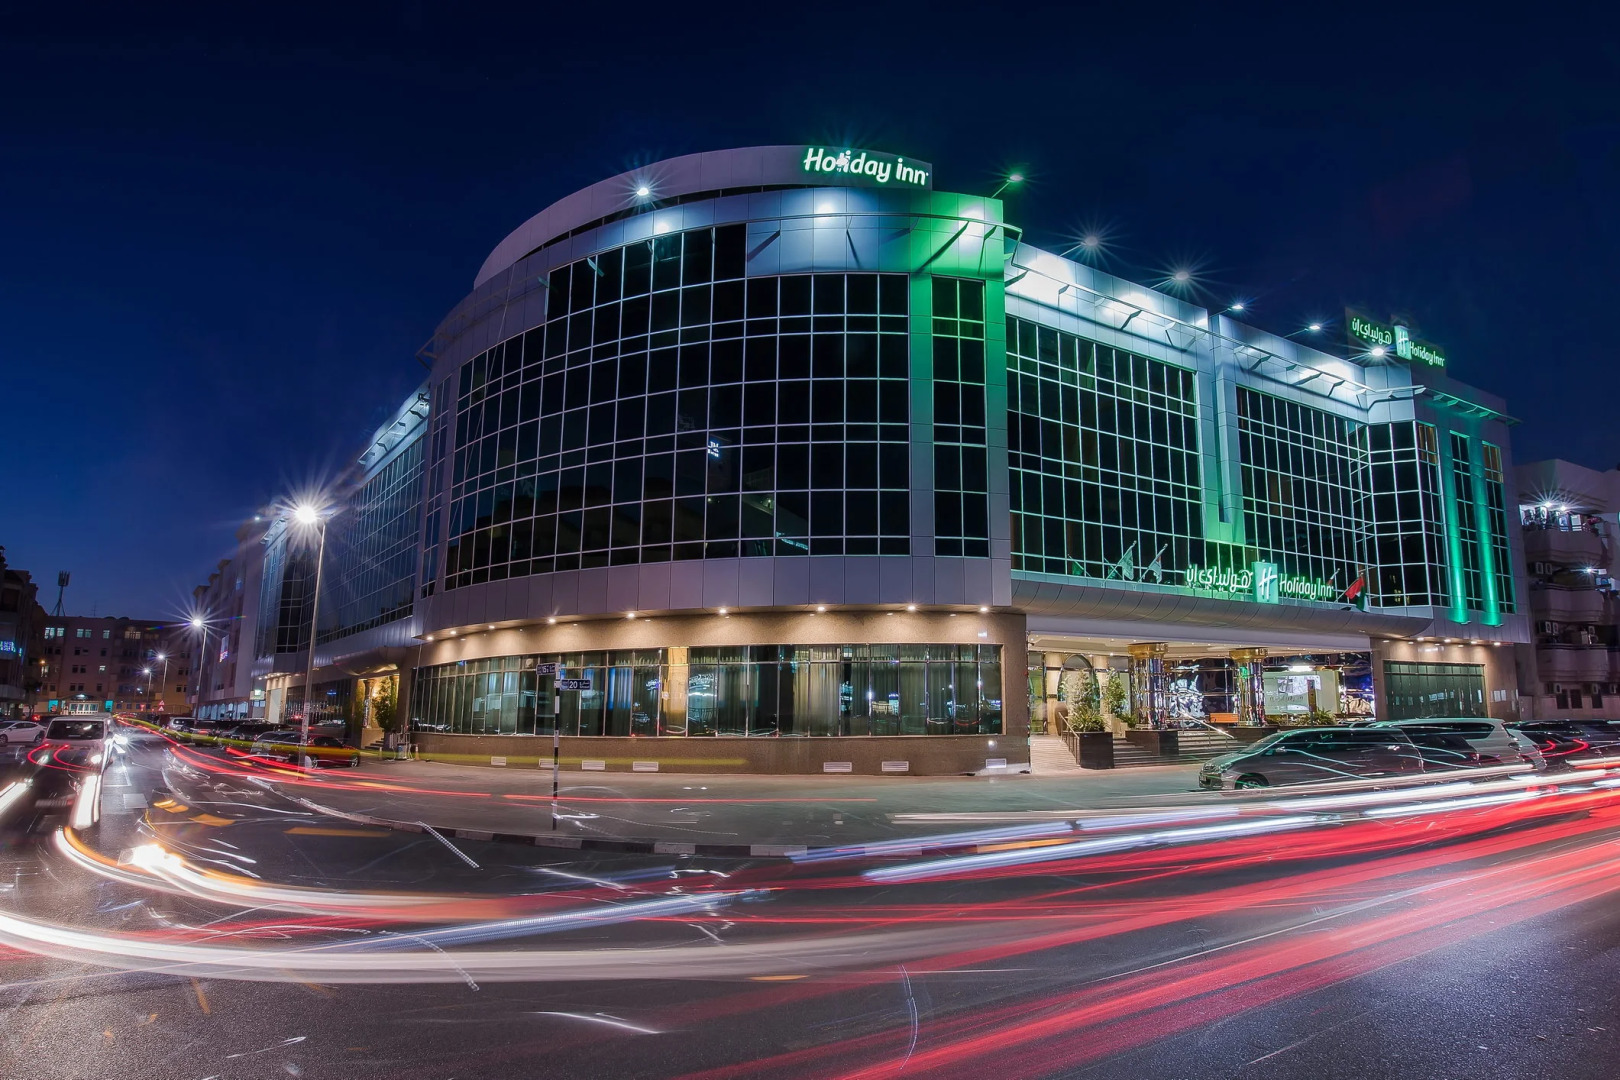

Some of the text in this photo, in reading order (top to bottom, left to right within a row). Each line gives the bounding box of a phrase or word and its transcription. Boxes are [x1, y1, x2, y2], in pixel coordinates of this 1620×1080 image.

[804, 148, 892, 182] Holiday
[1409, 341, 1434, 366] Holiday
[1199, 565, 1254, 593] هوليداي
[1279, 573, 1333, 600] Holiday Inn
[569, 681, 578, 689] 20
